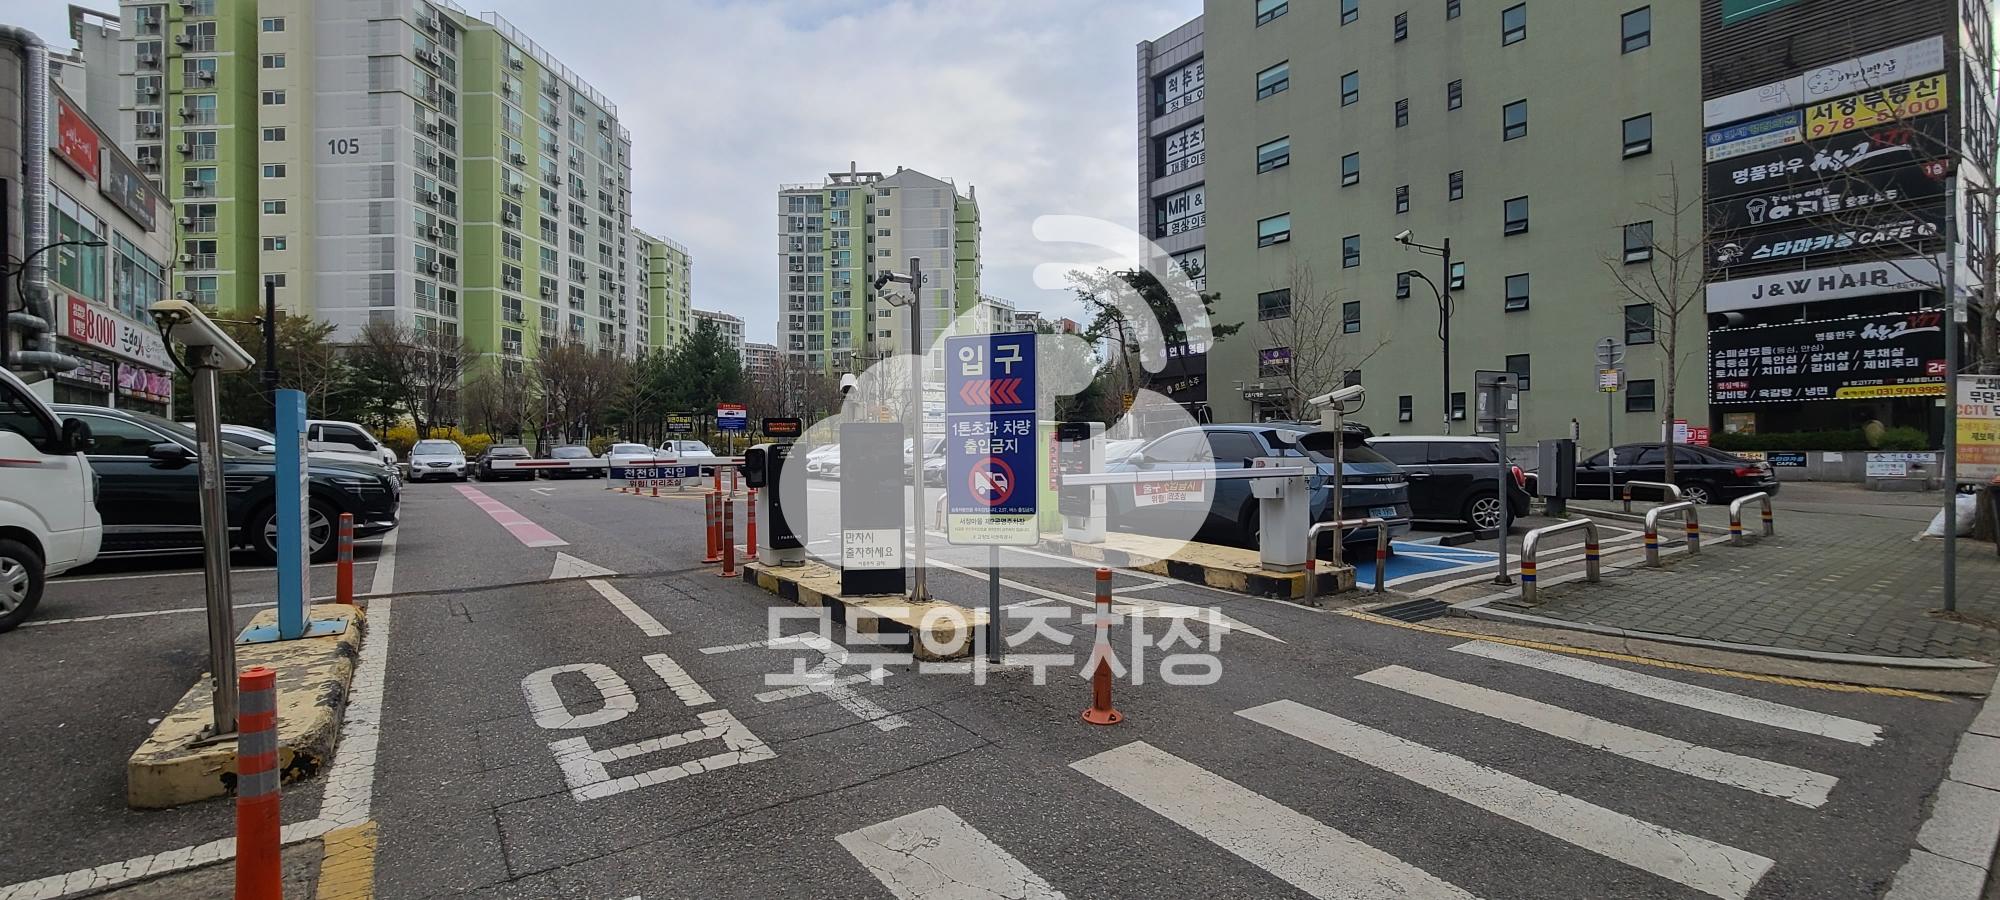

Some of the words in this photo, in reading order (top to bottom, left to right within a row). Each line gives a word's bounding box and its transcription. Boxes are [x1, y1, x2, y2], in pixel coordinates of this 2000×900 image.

[1813, 78, 1940, 120] 서정부동산
[1812, 98, 1940, 136] 978-5600
[328, 138, 359, 155] 105
[1732, 157, 1805, 185] 명품한우
[1168, 195, 1190, 216] MRI
[1751, 231, 1857, 260] 스타마카롱
[1858, 226, 1914, 245] CAFE
[1818, 269, 1889, 292] HAIR
[1815, 330, 1856, 342] 명품한우
[958, 344, 1023, 376] 입구
[1715, 358, 1749, 368] 특등심
[1761, 355, 1797, 365] 특안심
[1811, 351, 1849, 362] 살치살
[1863, 347, 1904, 359] 부채살
[1715, 368, 1749, 378] 토시살
[1761, 365, 1797, 375] 치마살
[1811, 361, 1849, 373] 갈비살
[1863, 357, 1919, 369] 제비추리
[1716, 390, 1748, 400] 갈비탕
[1805, 386, 1828, 396] 냉면
[1957, 404, 1988, 416] CCTV
[952, 420, 998, 437] 1톤초과
[1003, 419, 1031, 436] 차량
[964, 438, 1018, 455] 출입금지
[664, 466, 686, 478] 진입
[651, 479, 682, 487] 머리조심
[520, 631, 912, 801] 입구
